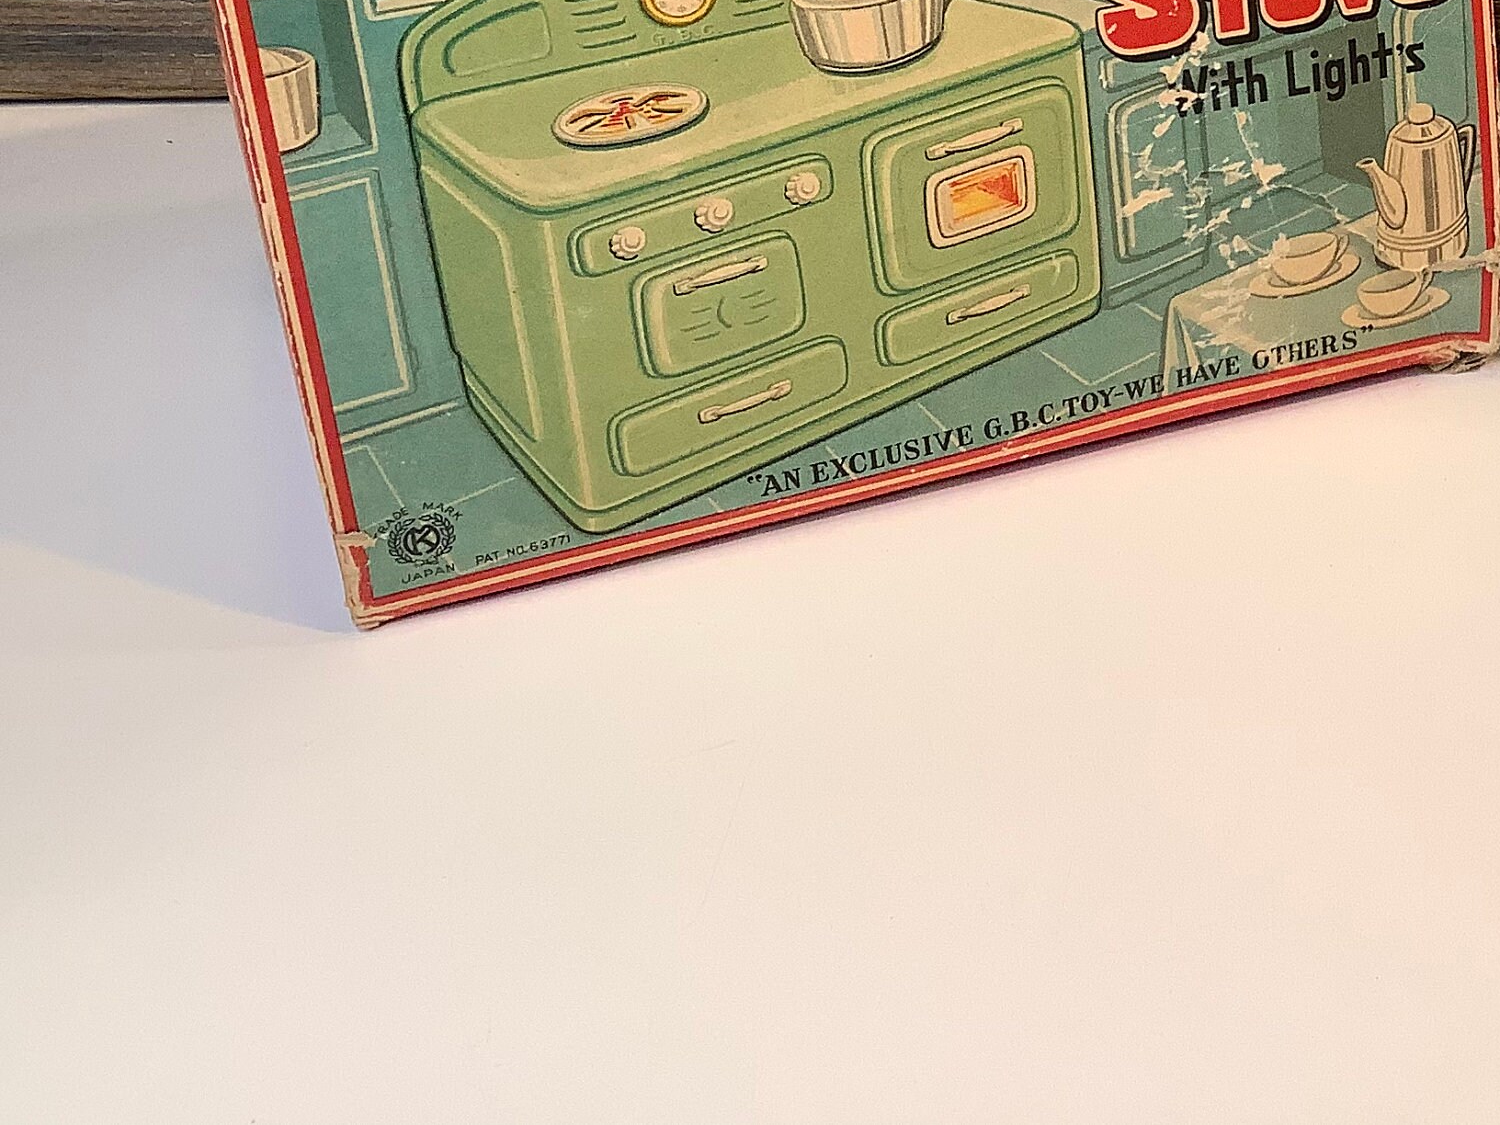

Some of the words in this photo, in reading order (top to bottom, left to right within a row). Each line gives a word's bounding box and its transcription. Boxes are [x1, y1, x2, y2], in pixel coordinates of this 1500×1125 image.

[1174, 62, 1269, 118] With
[810, 424, 975, 488] EXCLUSIVE
[1176, 355, 1241, 388] HAVE
[422, 501, 464, 521] MARK
[401, 562, 456, 585] JAPAN
